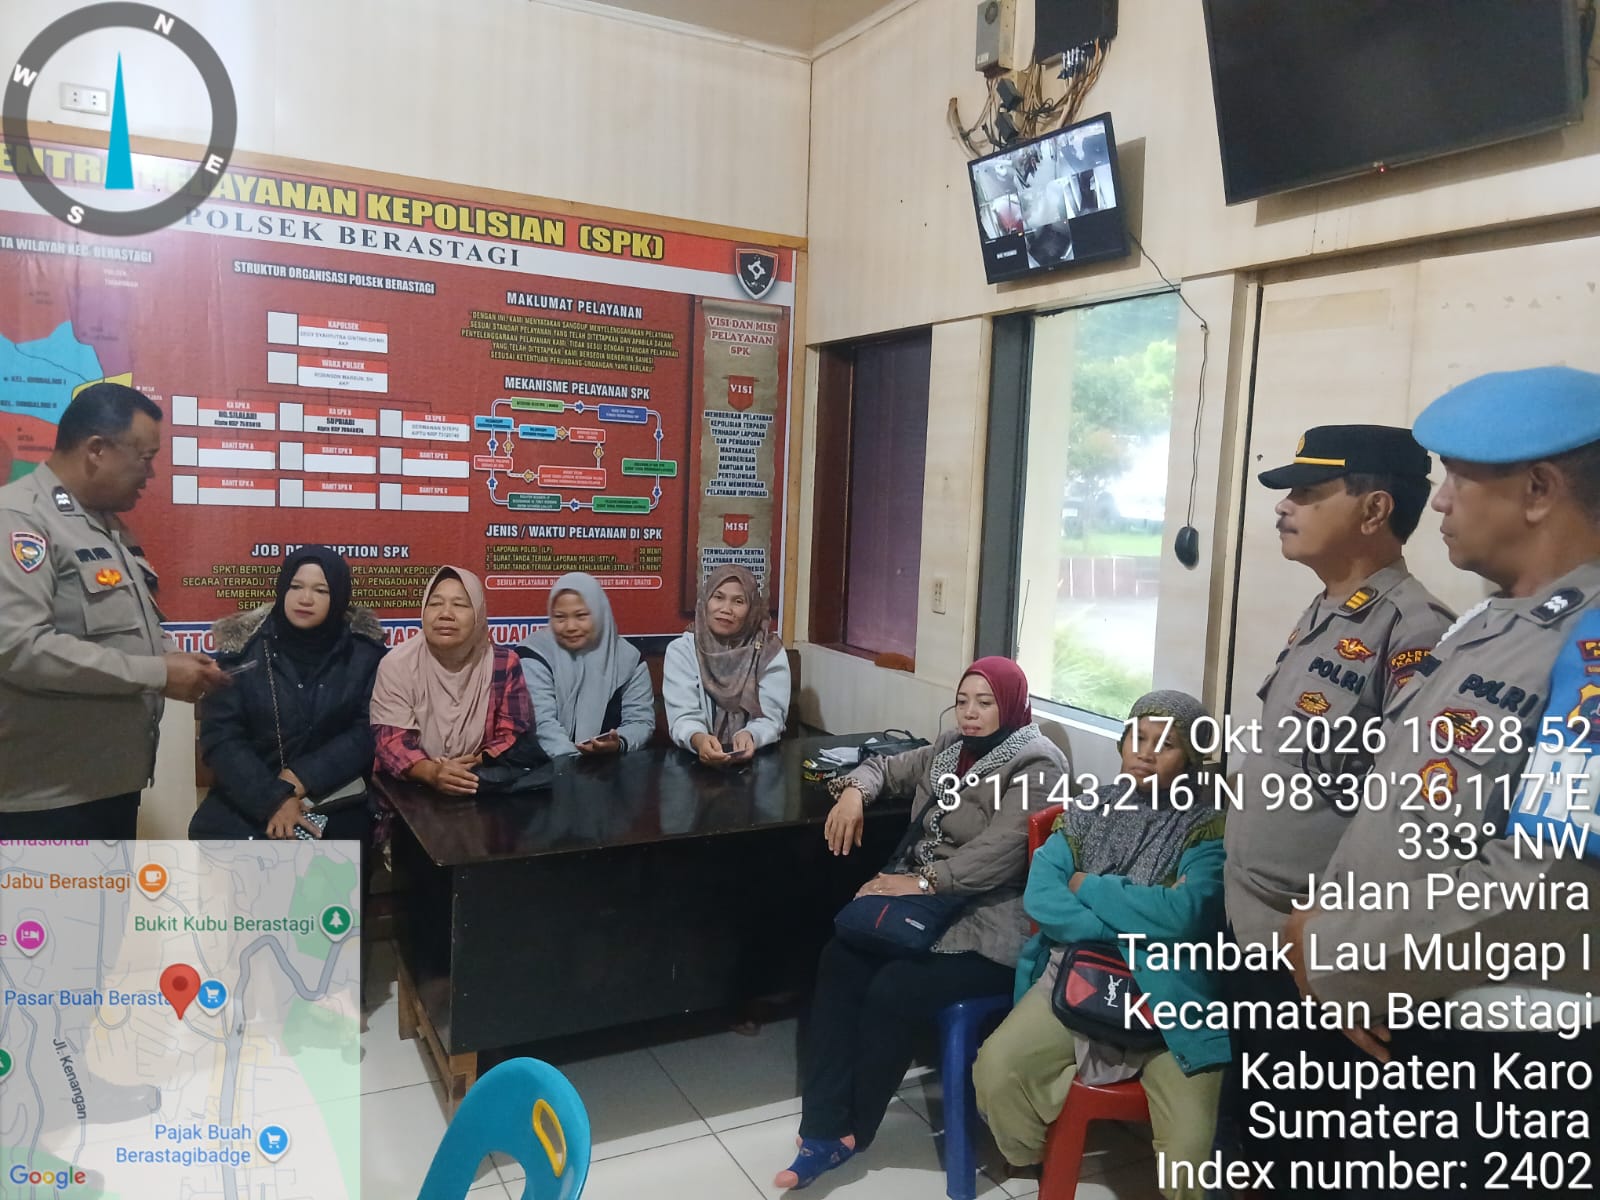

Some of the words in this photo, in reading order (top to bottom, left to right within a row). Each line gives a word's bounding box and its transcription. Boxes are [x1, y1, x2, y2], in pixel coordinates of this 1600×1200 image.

[0, 142, 104, 184] ENTR
[366, 192, 564, 248] KEPOLISIAN
[579, 225, 665, 260] (SPK)
[184, 203, 324, 242] POLSEK
[339, 225, 520, 268] BERASTAGI
[234, 260, 286, 278] STRUKTUR
[288, 267, 348, 285] ORGANISASI
[348, 271, 384, 288] POLSEK
[384, 277, 435, 295] BERASTAGI
[506, 291, 573, 312] MAKLUMAT
[577, 299, 643, 319] PELAYANAN
[707, 316, 732, 328] VISI
[731, 319, 754, 331] DAN
[755, 321, 777, 333] MISI
[711, 330, 773, 345] PELAYANAN
[730, 345, 750, 356] SPK
[504, 376, 569, 394] MEKANISME
[571, 379, 628, 398] PELAYANAN
[630, 386, 650, 400] SPK
[730, 383, 753, 395] VISI
[485, 524, 519, 539] JENIS
[528, 525, 566, 539] WAKTU
[568, 526, 628, 540] PELAYANAN
[629, 527, 640, 540] DI
[642, 527, 663, 541] SPK
[725, 522, 749, 531] MISI
[251, 544, 280, 557] JOB
[383, 546, 409, 558] SPK
[212, 565, 237, 574] SPKT
[239, 565, 282, 574] BERTUGA
[352, 566, 401, 575] PELAYANAN
[404, 566, 441, 575] KEPOLIS
[182, 577, 220, 586] SECARA
[223, 577, 265, 587] TERPADU
[368, 577, 420, 586] PENGADUAN
[351, 588, 411, 598] ERTOLONGAN,
[347, 600, 383, 608] AYANAN
[383, 600, 424, 608] INFORMA
[164, 630, 216, 653] TTO
[1307, 655, 1368, 696] POLRI
[1458, 673, 1540, 718] POLRI
